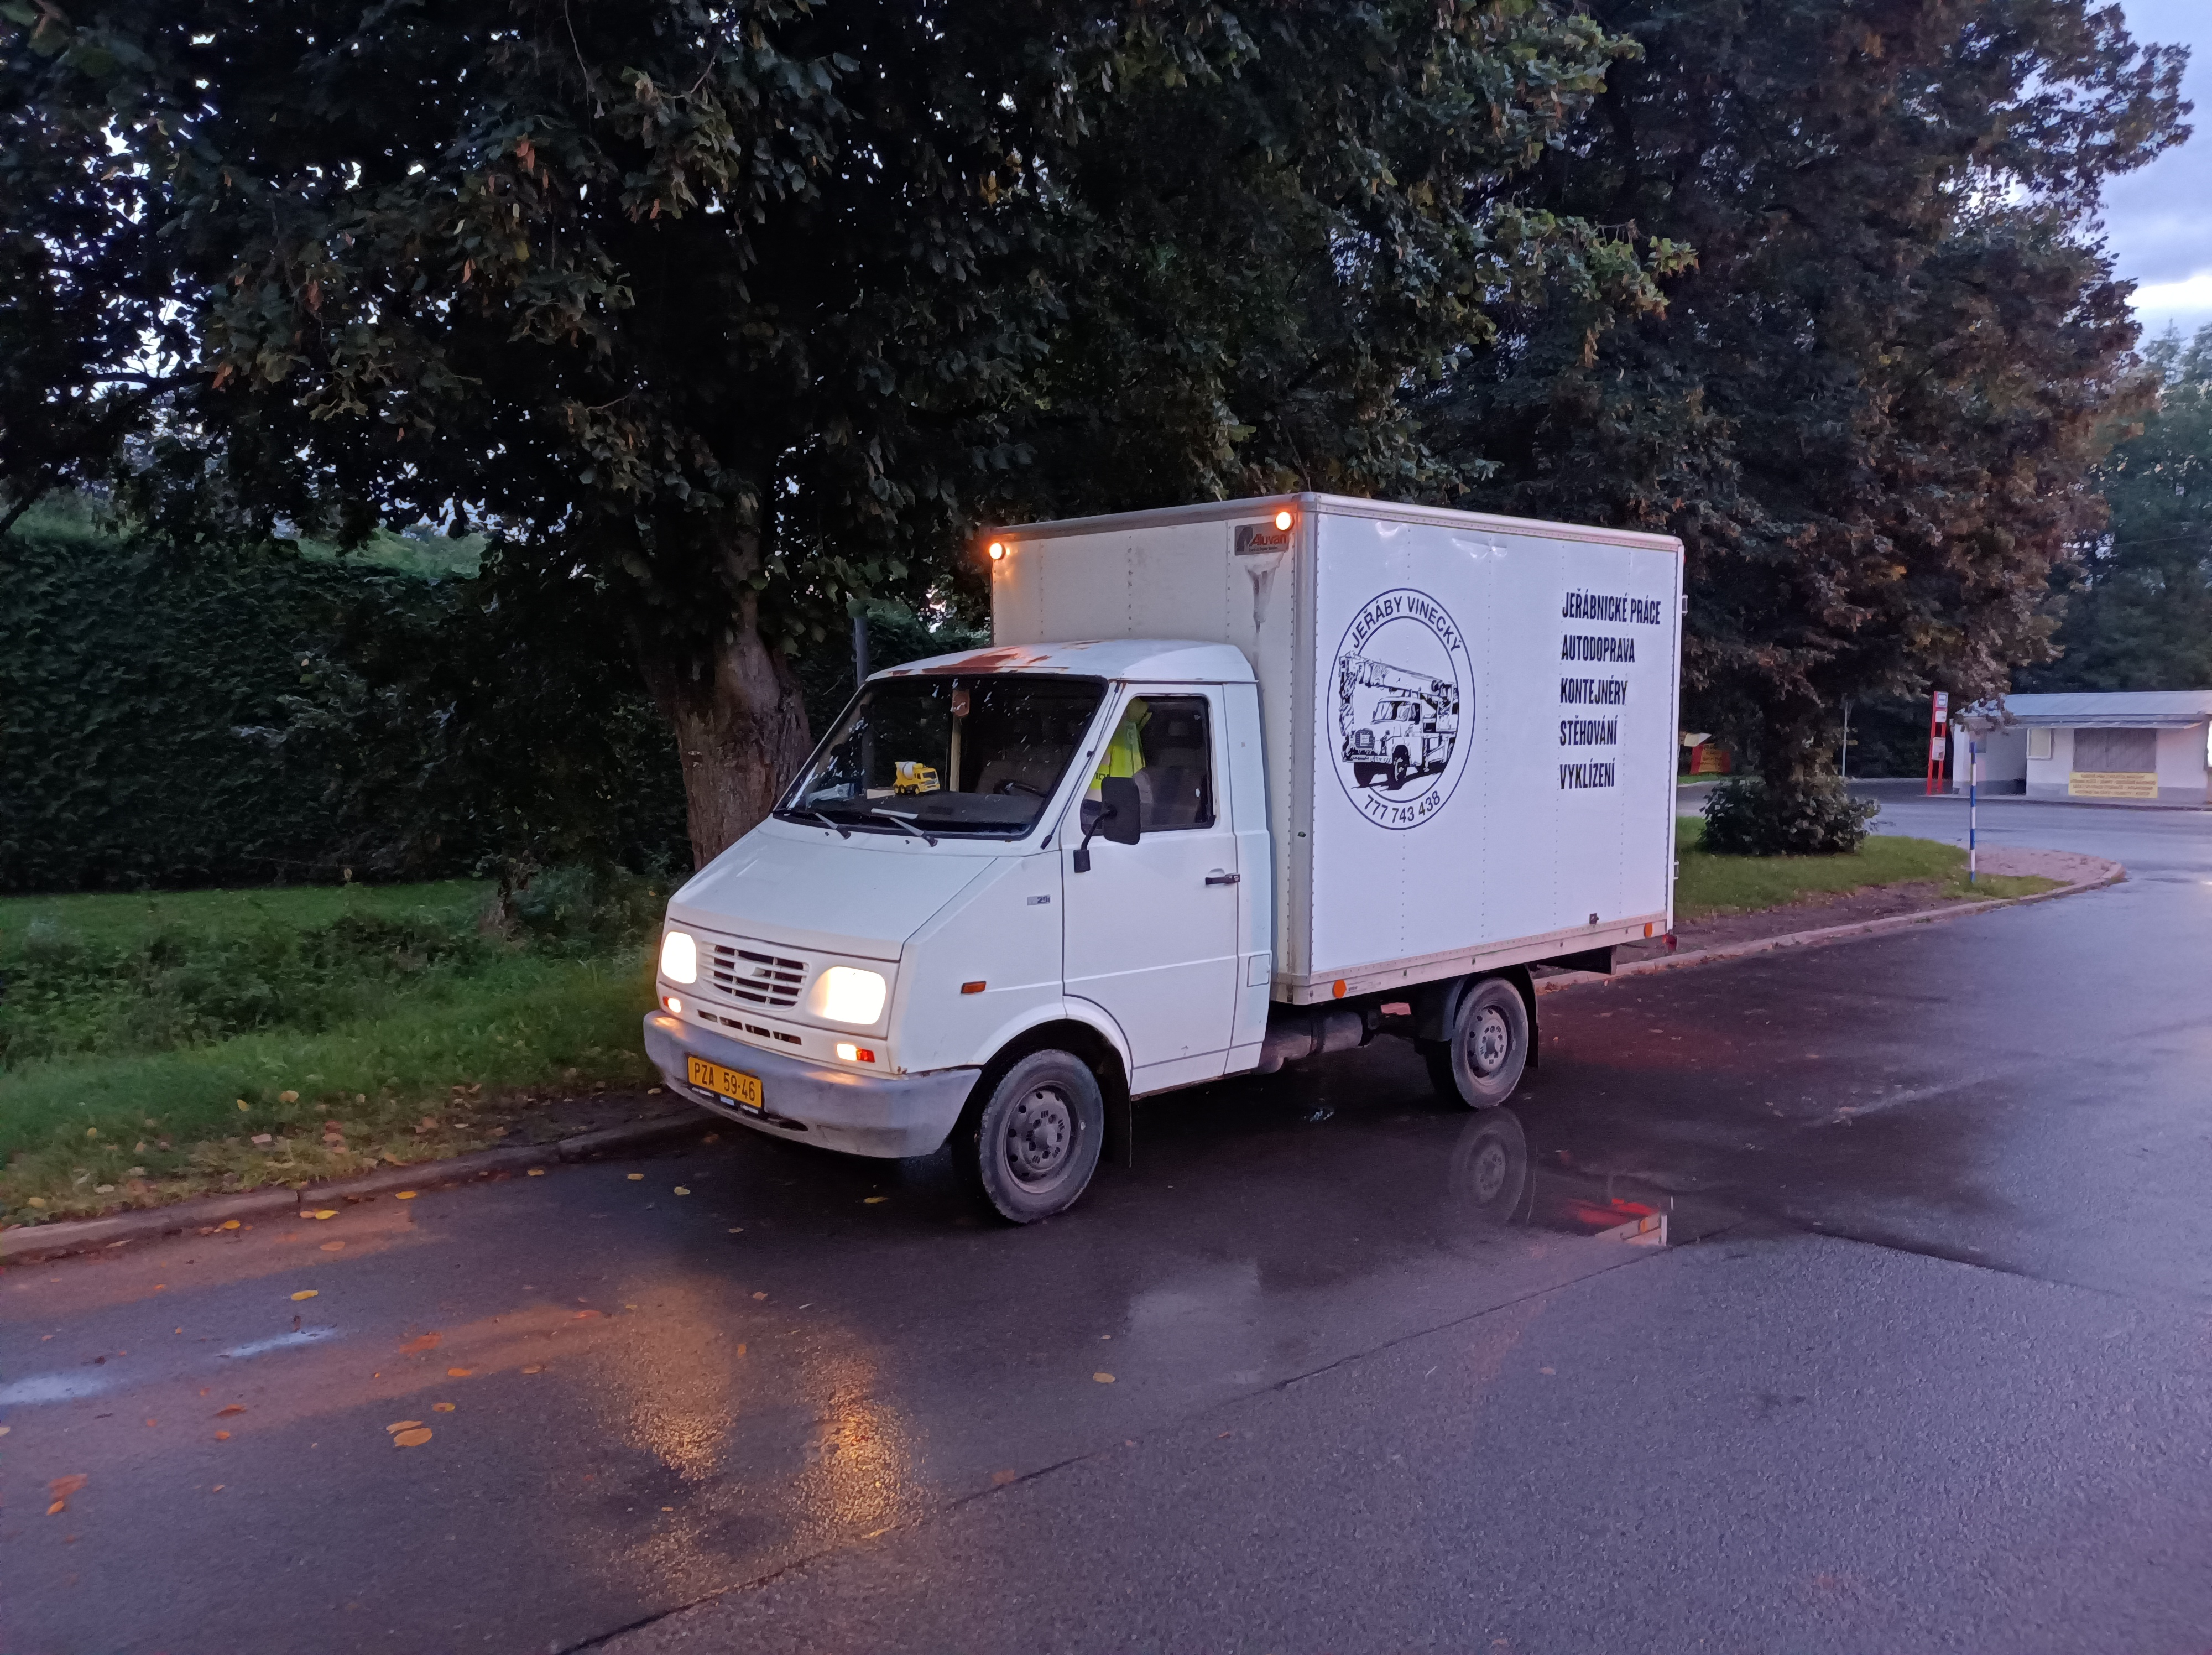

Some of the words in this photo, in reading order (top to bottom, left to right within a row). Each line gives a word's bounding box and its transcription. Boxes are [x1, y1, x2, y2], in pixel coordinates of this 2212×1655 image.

[1562, 587, 1628, 622] JEŘÁBNICKÉ
[1630, 595, 1661, 625] PRÁCE
[1353, 596, 1402, 648] JEŘÁBY
[1407, 596, 1461, 652] VINECKÝ
[1561, 634, 1635, 663] AUTODOPRAVA
[1560, 675, 1628, 705] KONTEJNÉRY
[1559, 715, 1618, 746] STĚHOVÁNÍ
[1559, 757, 1615, 790] VYKLÍZENÍ
[1364, 794, 1388, 820] 777
[1392, 807, 1415, 823] 743
[1418, 791, 1441, 816] 438
[694, 1062, 714, 1087] PZA
[723, 1072, 755, 1101] 59-46
